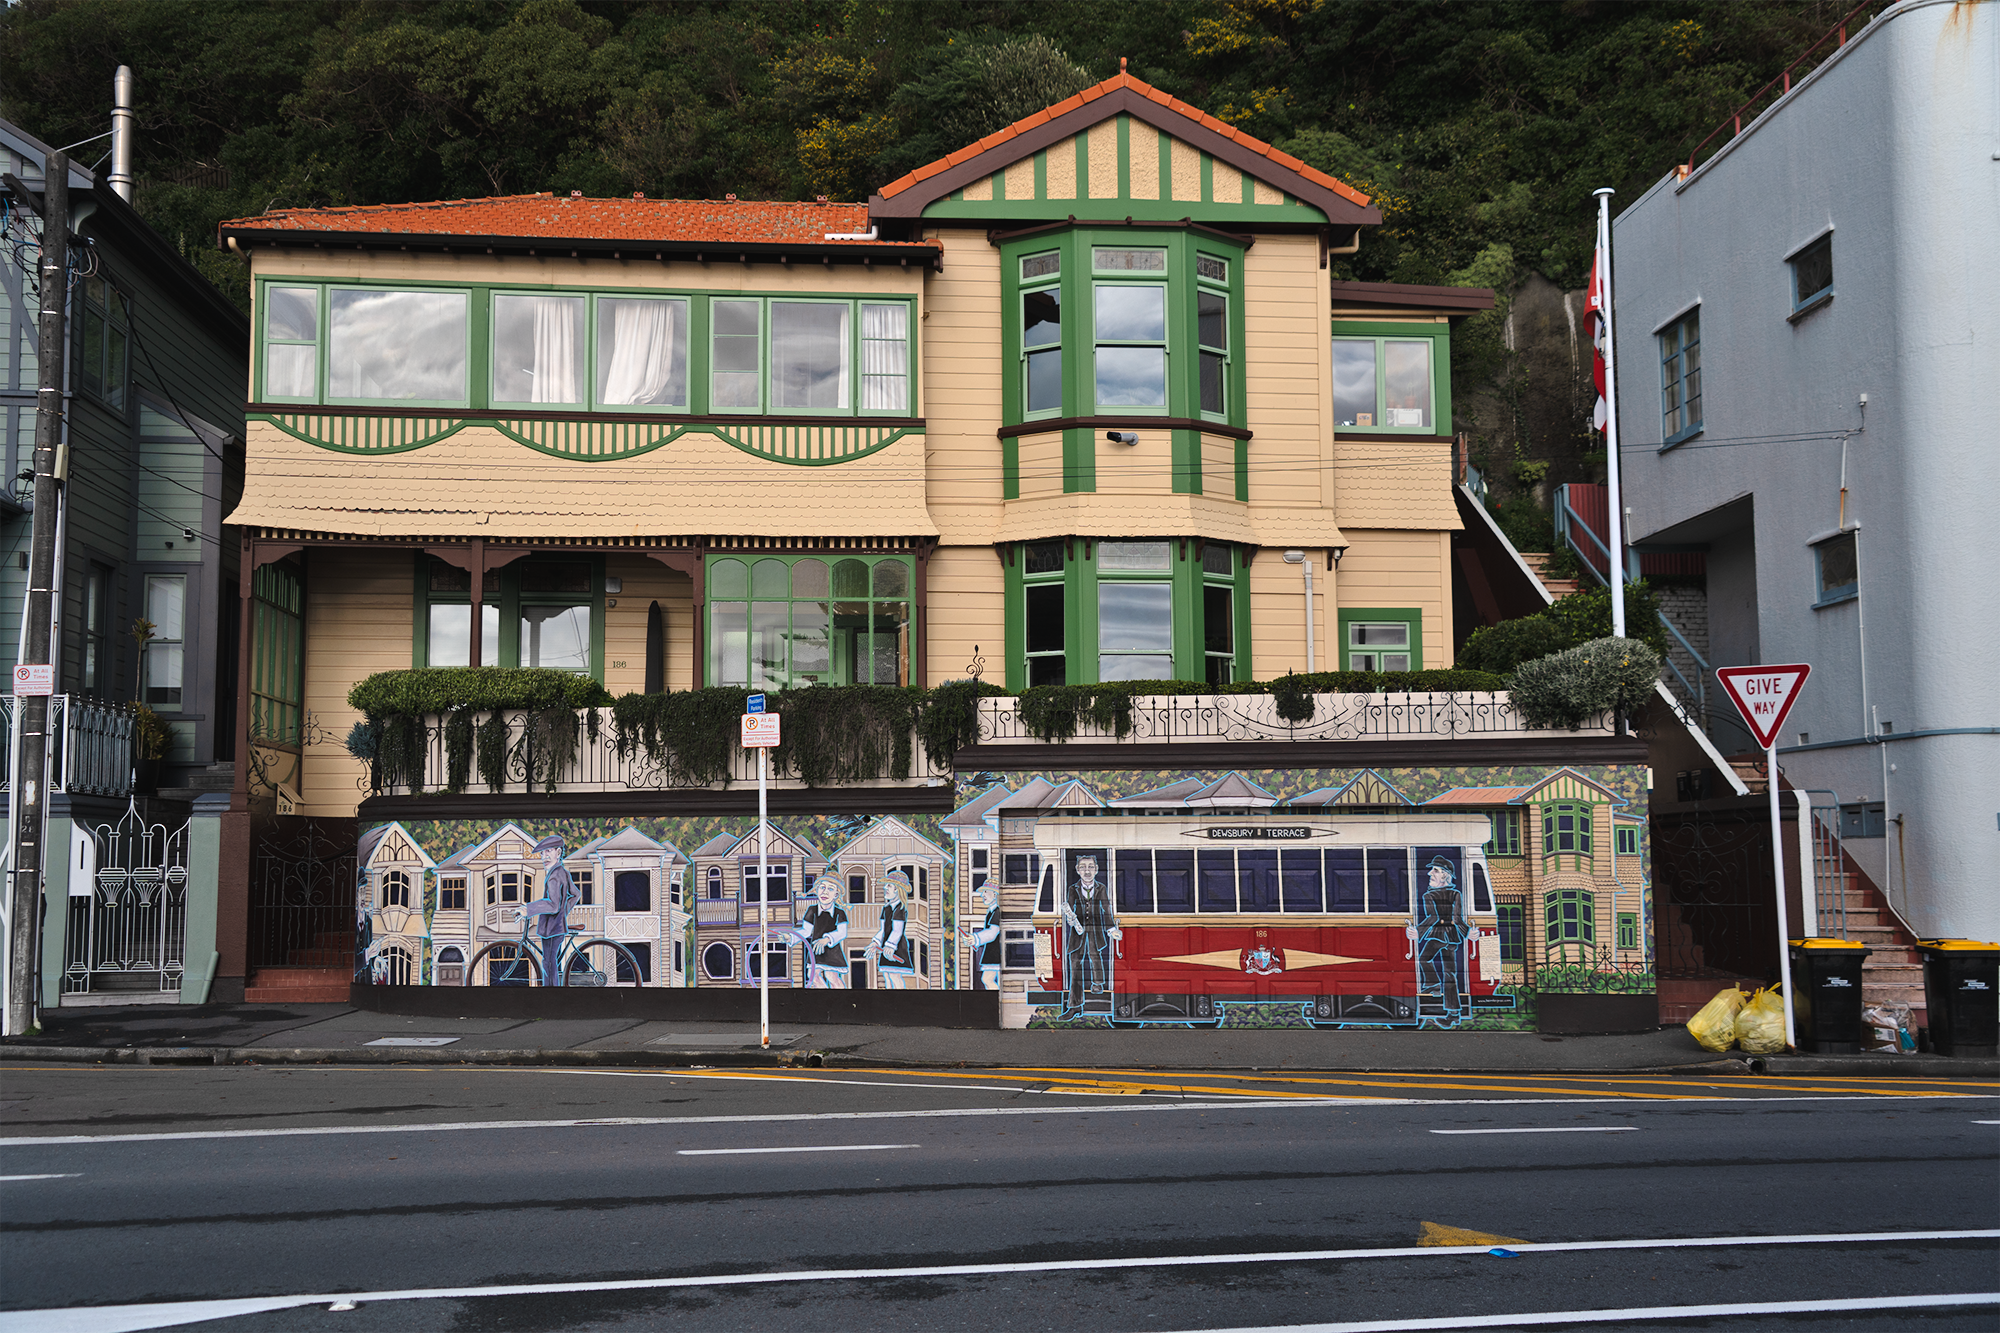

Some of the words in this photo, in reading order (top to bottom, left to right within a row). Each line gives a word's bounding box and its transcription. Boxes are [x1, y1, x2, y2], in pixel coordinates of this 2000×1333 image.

[612, 660, 627, 669] 186
[1746, 677, 1782, 695] GIVE
[1753, 701, 1776, 715] WAY
[278, 804, 293, 812] 186
[1212, 828, 1254, 838] DEWSBURY
[1266, 828, 1306, 838] TERRACE
[1255, 930, 1268, 938] 186
